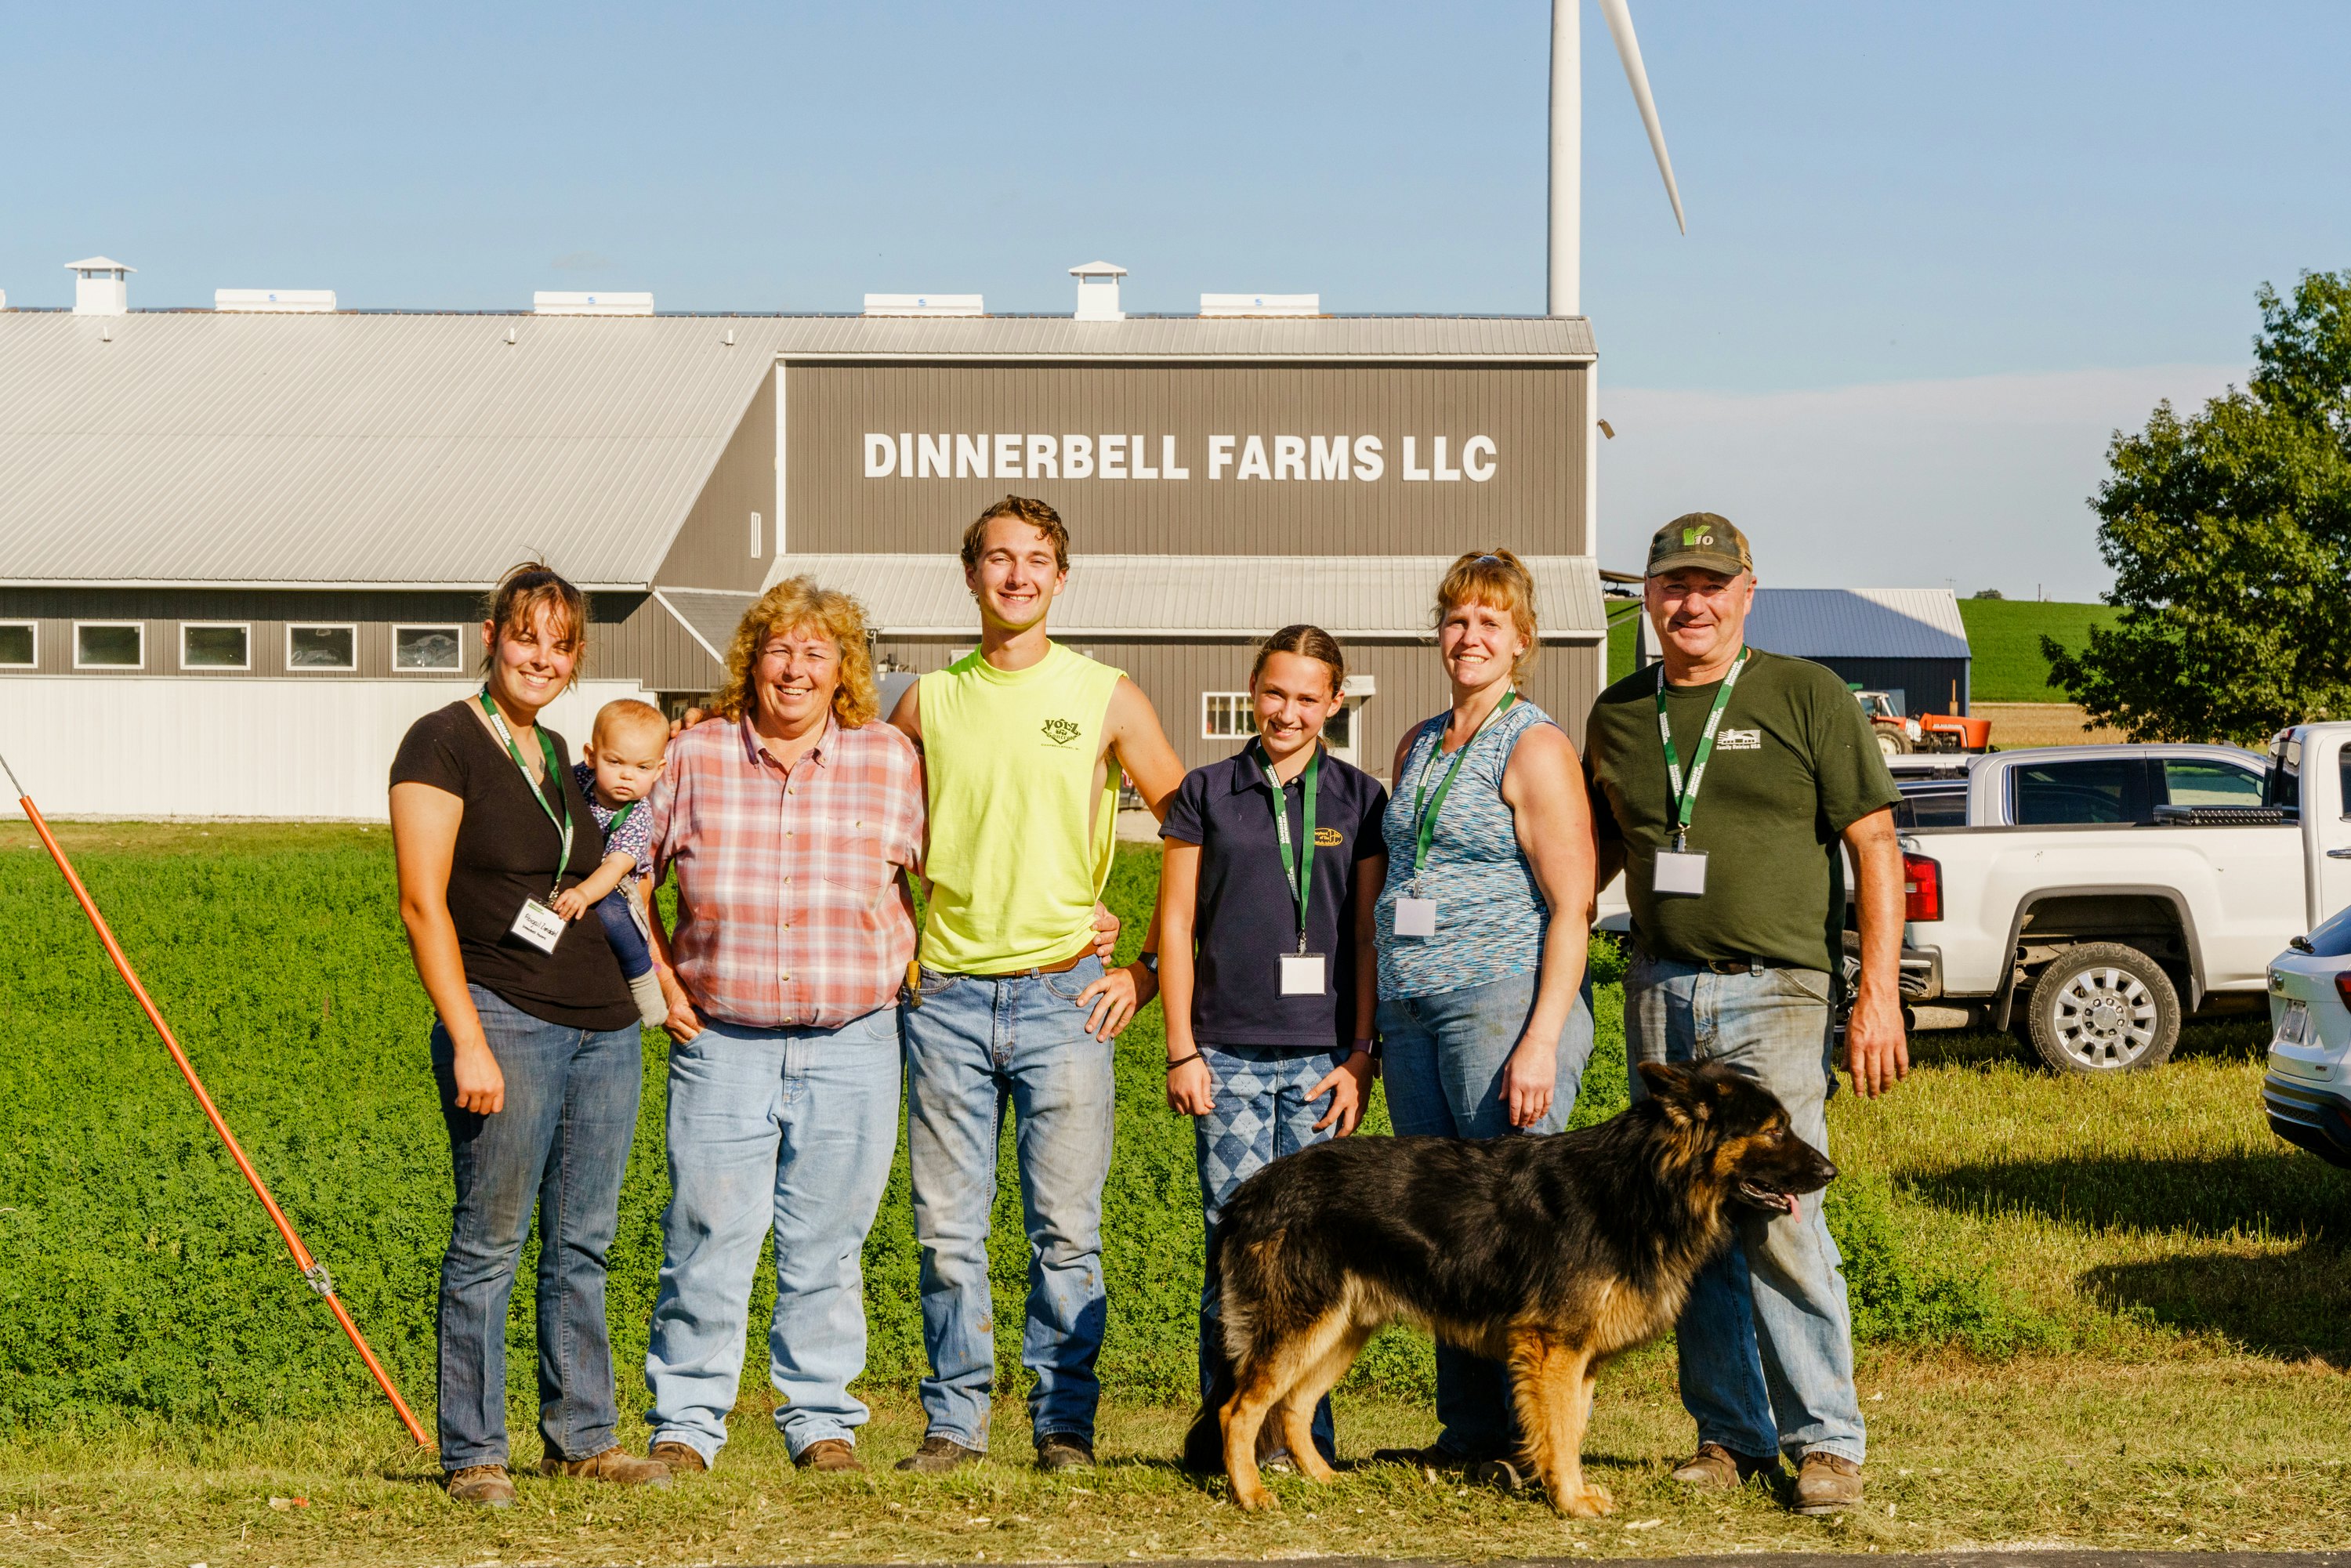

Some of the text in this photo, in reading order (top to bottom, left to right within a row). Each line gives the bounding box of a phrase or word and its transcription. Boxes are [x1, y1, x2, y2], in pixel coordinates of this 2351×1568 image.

[864, 433, 1498, 483] DINNERBELL FARMS LLC
